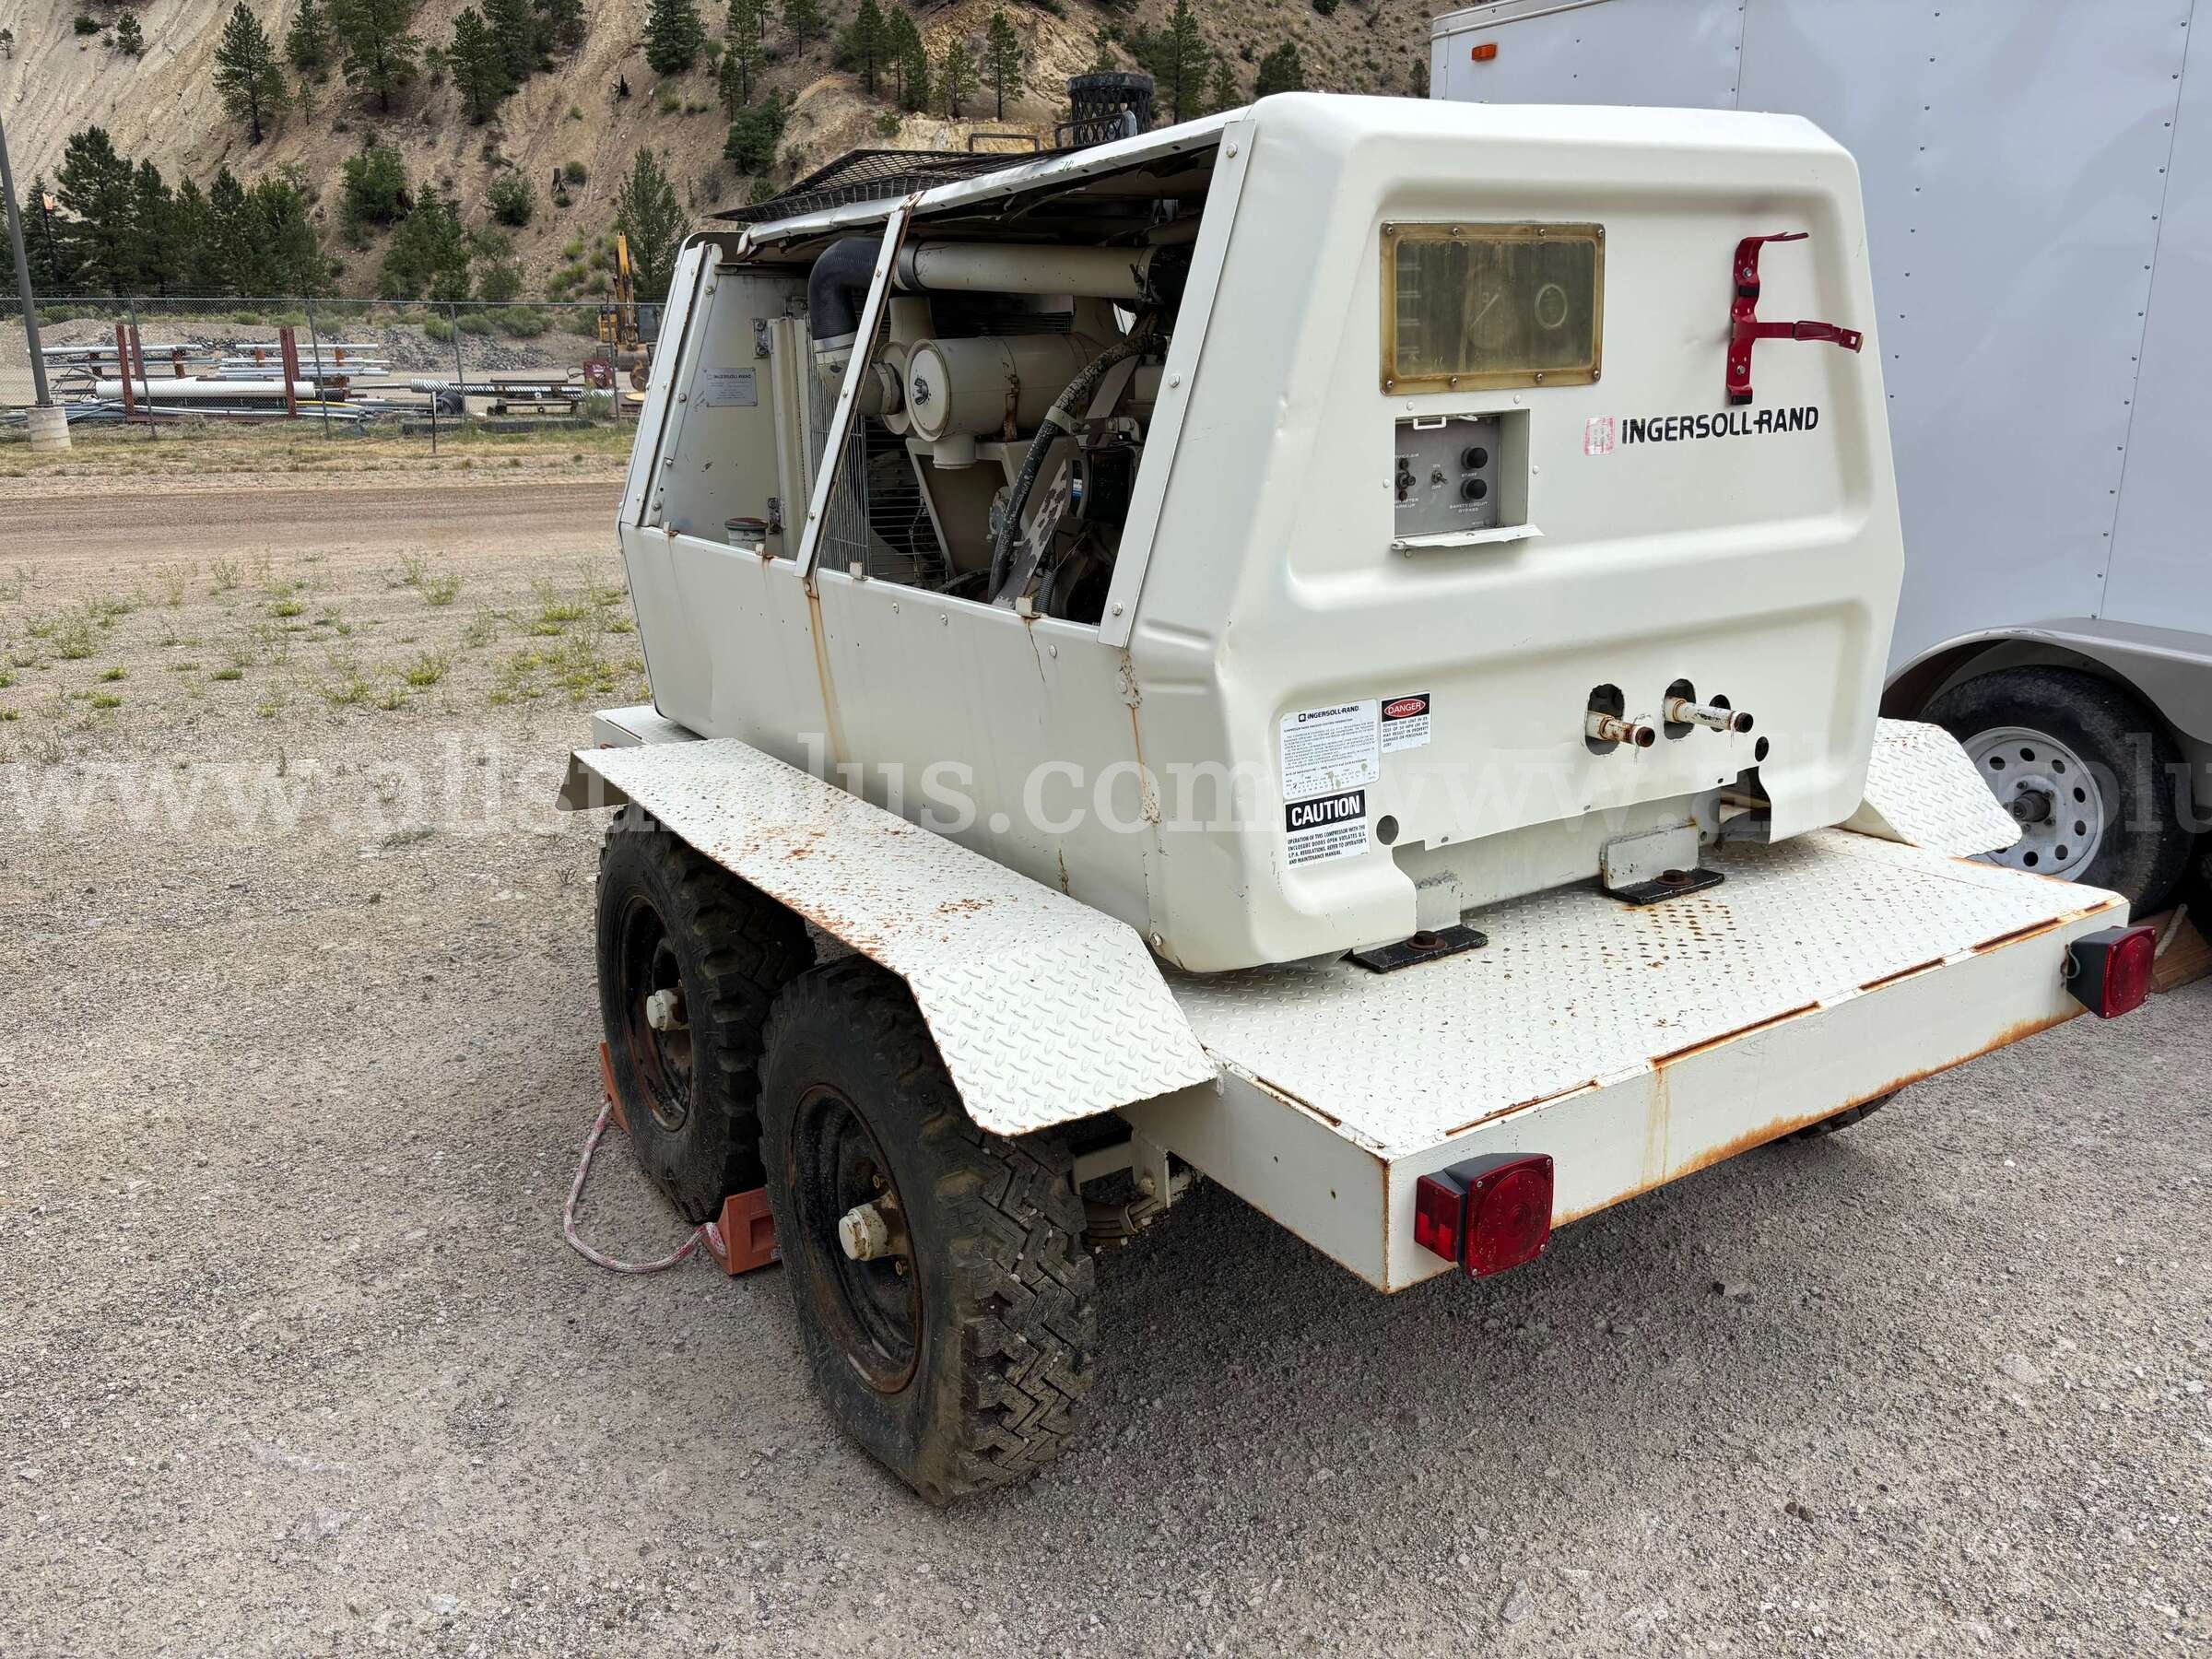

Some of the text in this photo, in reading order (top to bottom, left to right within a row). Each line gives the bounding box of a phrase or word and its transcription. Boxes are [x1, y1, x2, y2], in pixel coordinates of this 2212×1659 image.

[1622, 406, 1819, 444] INGERSOLL-RAND
[1307, 705, 1359, 720] INGERSOLL-RAND
[1387, 701, 1421, 714] DANGER
[1291, 794, 1360, 827] CAUTION
